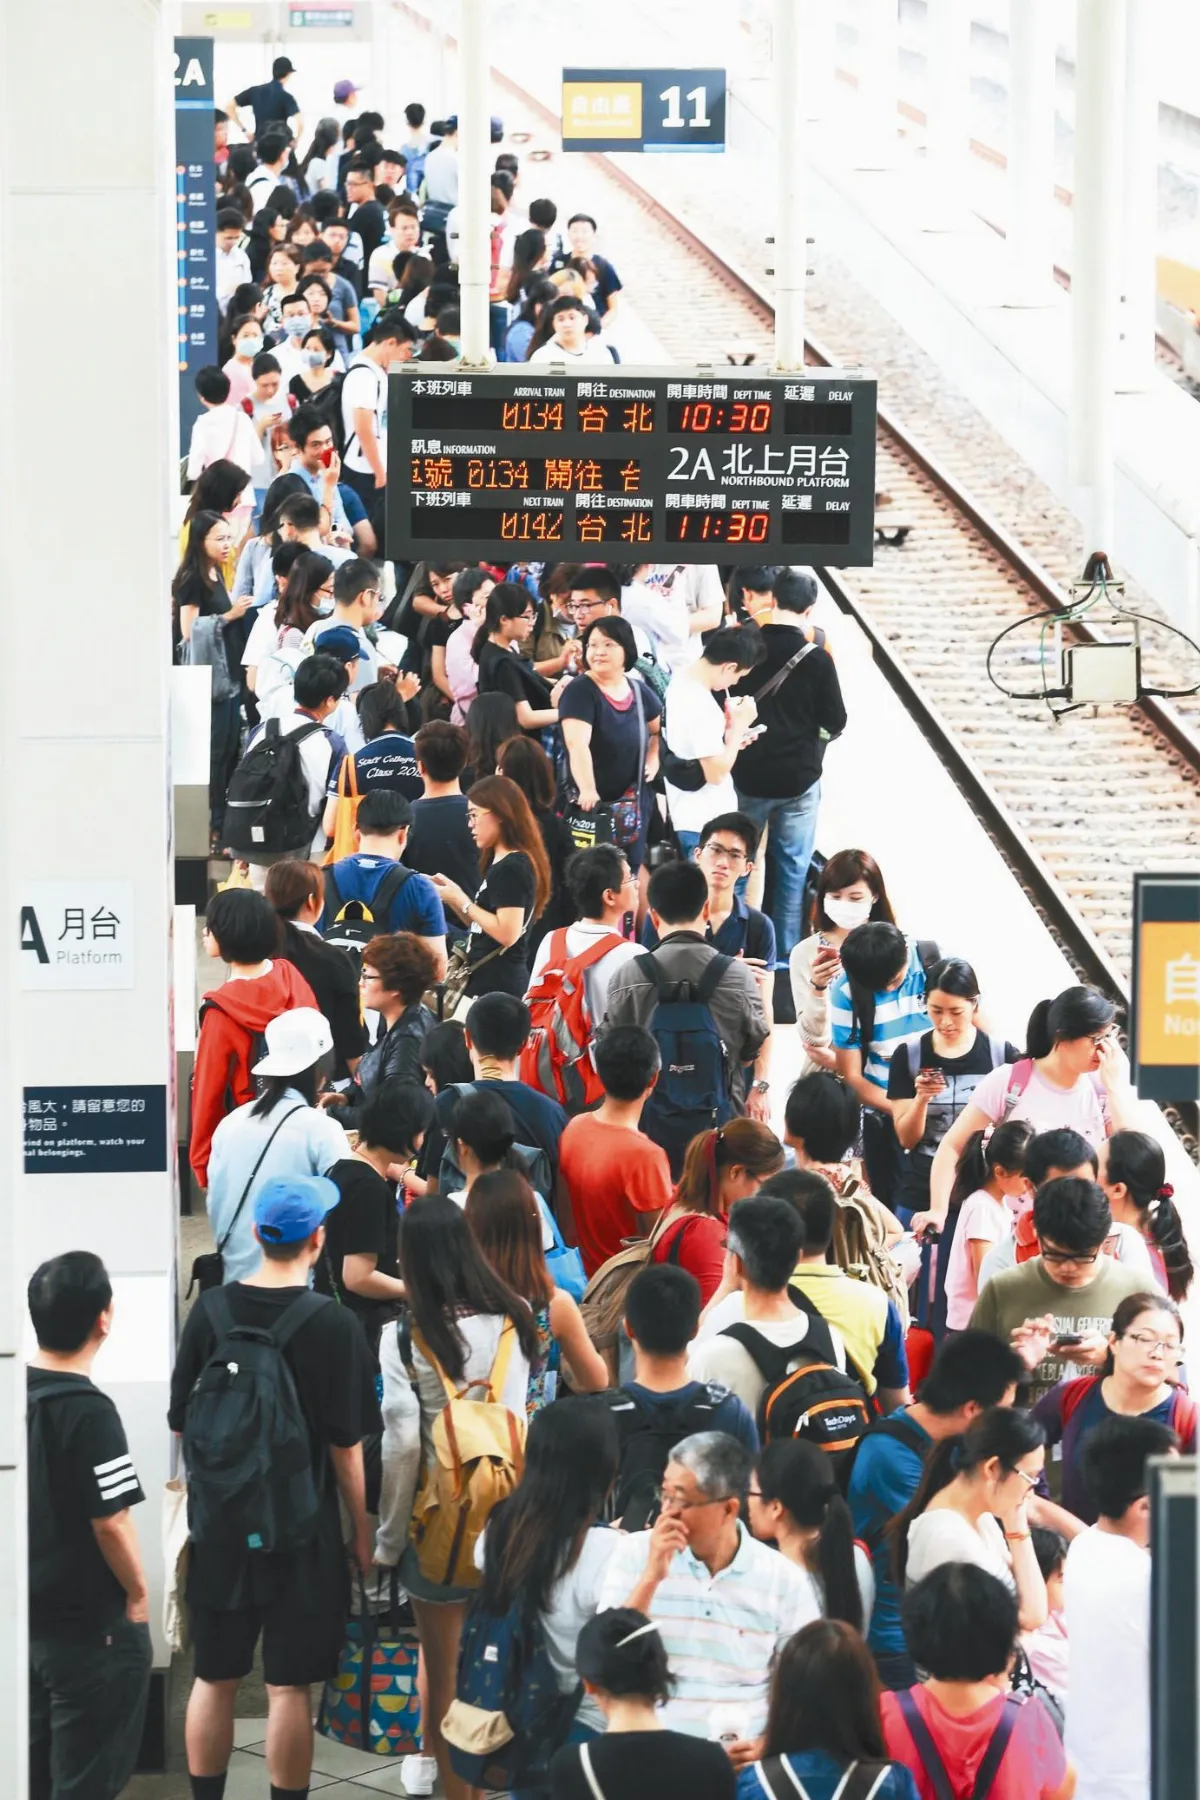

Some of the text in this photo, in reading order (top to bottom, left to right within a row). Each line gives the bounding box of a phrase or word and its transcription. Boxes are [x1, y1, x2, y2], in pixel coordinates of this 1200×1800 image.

[659, 85, 711, 127] 11
[411, 379, 473, 396] 本班列車
[514, 387, 565, 397] ARRIVAL TRAIN
[577, 382, 608, 398] 開往
[609, 388, 656, 399] DESTINATION
[667, 383, 728, 399] 開車時間
[734, 390, 772, 400] DEPT TIME
[784, 385, 815, 401] 延遲
[829, 391, 854, 401] DELAY
[502, 402, 564, 431] 0134
[681, 403, 771, 432] 10:30
[411, 439, 442, 454] 訊息
[443, 445, 496, 454] INFORMATION
[667, 443, 850, 481] 2A 北上月台
[467, 459, 529, 488] 0134
[545, 459, 603, 491] 開往
[721, 476, 850, 488] NORTHBOUND PLATFORM
[410, 491, 472, 507] 下班列車
[523, 497, 564, 507] NEXT TRAIN
[575, 493, 606, 508] 開往
[607, 498, 653, 508] DESTINATION
[665, 493, 726, 509] 開車時間
[732, 500, 770, 510] DEPT TIME
[781, 494, 813, 510] 延遲
[826, 501, 851, 511] DELAY
[501, 512, 563, 540] 0142
[679, 514, 769, 542] 11:30
[357, 756, 382, 768] Staff
[366, 766, 424, 779] Class 201
[21, 906, 120, 964] A 月台
[56, 950, 122, 964] Platform
[1165, 952, 1200, 1005] 自
[1164, 1013, 1200, 1036] No
[57, 1138, 97, 1148] platform,
[99, 1138, 124, 1146] watch
[126, 1139, 146, 1147] your
[38, 1149, 86, 1158] belongings.
